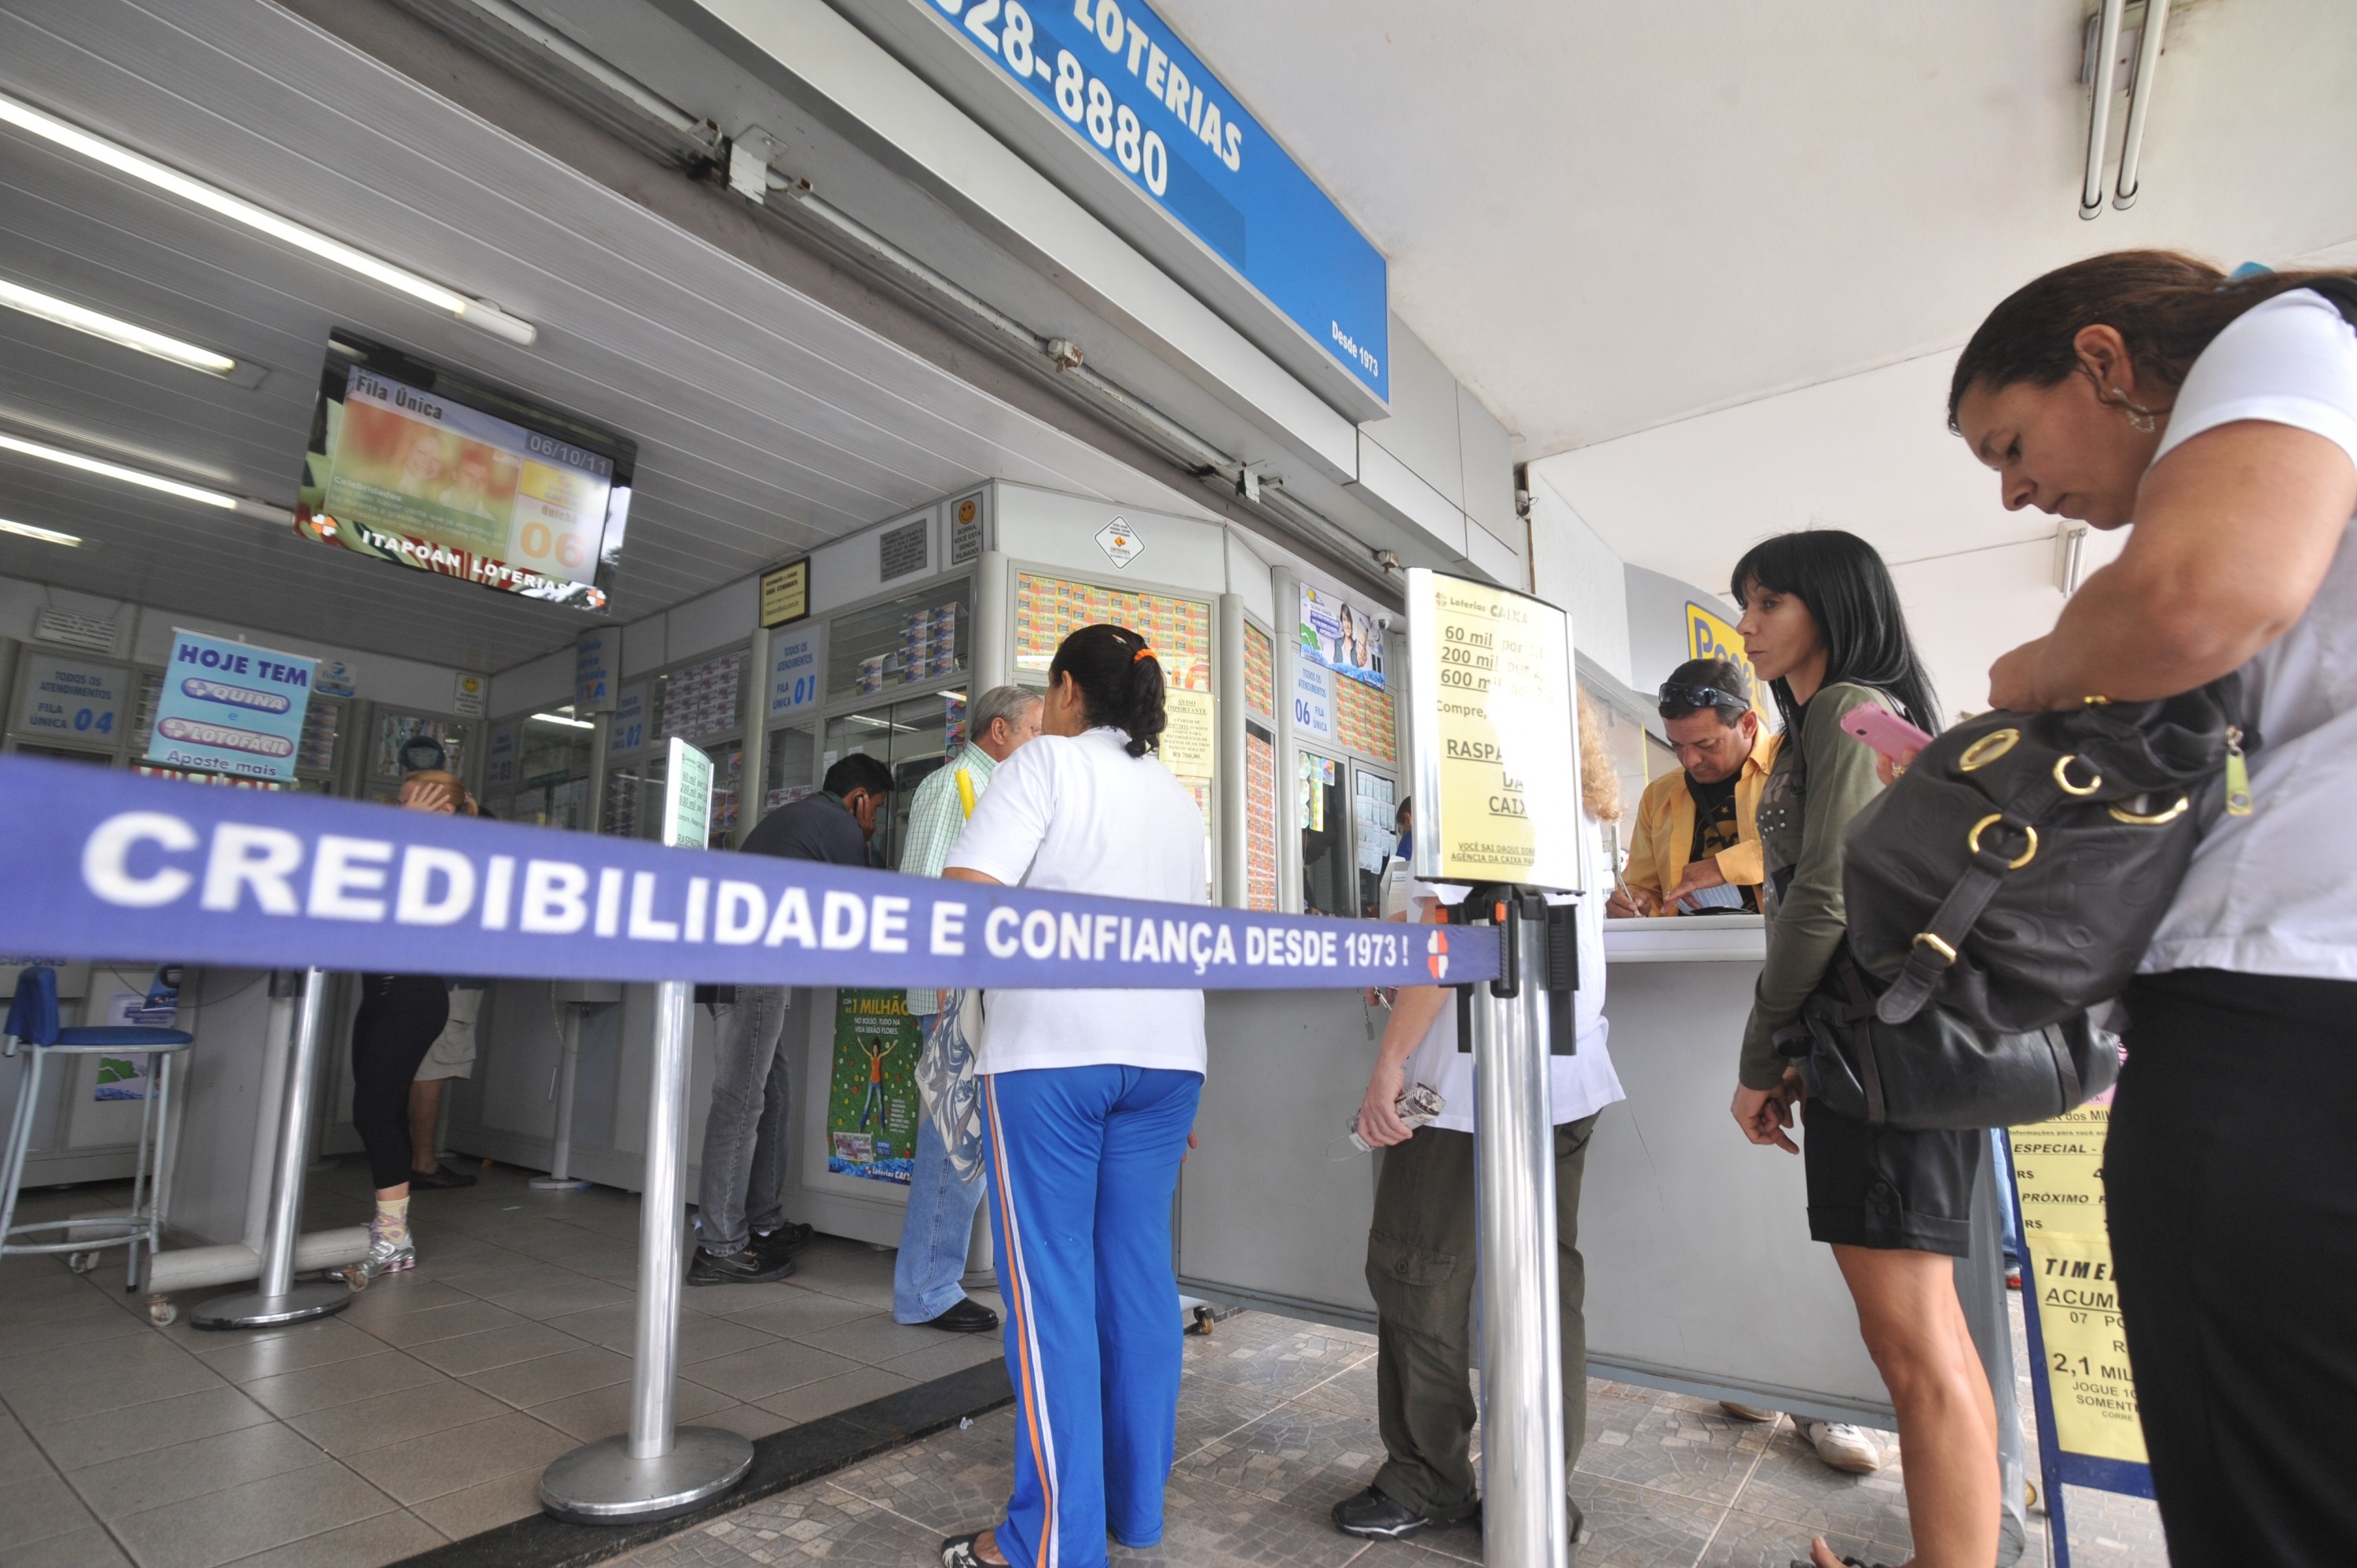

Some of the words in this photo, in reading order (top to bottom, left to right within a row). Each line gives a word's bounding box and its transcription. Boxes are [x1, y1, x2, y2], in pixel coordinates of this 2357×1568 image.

[1073, 0, 1241, 172] LOTERIAS
[936, 0, 1168, 196] 28-8880
[1332, 320, 1358, 358] Desde
[1359, 346, 1378, 377] 1973
[355, 374, 388, 401] Fila
[395, 387, 442, 420] Única
[530, 435, 607, 474] 06/10/11
[520, 521, 585, 569] 06
[362, 530, 461, 568] ITAPOAN
[473, 560, 568, 593] LOTERIAS
[1450, 597, 1486, 612] Loterias
[1445, 626, 1464, 641] 60
[1470, 632, 1493, 647] mil
[784, 644, 799, 657] TODOS
[801, 642, 808, 652] OS
[1441, 647, 1471, 664] 200
[1476, 654, 1499, 669] mil
[178, 643, 250, 675] HOJE
[258, 660, 307, 687] TEM
[777, 654, 812, 672] ATENDIMENTOS
[55, 671, 86, 684] TODOS
[89, 676, 101, 686] OS
[1303, 668, 1316, 681] TODOS
[1316, 674, 1321, 684] OS
[1441, 669, 1472, 687] 600
[40, 682, 112, 700] ATENDIMENTOS
[777, 682, 789, 694] FILA
[794, 675, 815, 704] 01
[1298, 679, 1326, 698] ATENDIMENTOS
[211, 686, 284, 710] QUINA
[773, 697, 791, 710] ÚNICA
[38, 702, 63, 714] FILA
[228, 712, 238, 720] e
[1168, 705, 1206, 714] IMPORTANTE
[1296, 698, 1310, 725] 06
[1315, 705, 1325, 716] FILA
[1437, 701, 1487, 720] Compre,
[30, 713, 68, 729] ÚNICA
[74, 708, 115, 735] 04
[1313, 716, 1328, 732] ÚNICA
[190, 726, 288, 755] LOTOFÁCIL
[627, 723, 642, 747] 02
[166, 750, 230, 771] Aposte
[236, 763, 277, 776] mais
[680, 783, 690, 793] 200
[680, 795, 689, 806] 600
[1458, 841, 1479, 851] VOCÊ
[1497, 844, 1519, 855] DAQUI
[1451, 851, 1486, 862] AGÊNCIA
[1501, 855, 1522, 864] CAIXA
[80, 811, 908, 953] CREDIBILIDADE
[930, 902, 967, 956] E
[984, 905, 1237, 976] CONFIANÇA
[1246, 926, 1337, 967] DESDE
[1344, 932, 1397, 968] 1973
[852, 998, 857, 1013] 1
[860, 995, 910, 1016] MILHÃO
[866, 1025, 880, 1034] SERÃO
[2066, 1112, 2087, 1121] dos
[2014, 1144, 2087, 1153] ESPECIAL
[872, 1167, 894, 1177] Loterias
[2017, 1170, 2034, 1179] R$
[2022, 1192, 2089, 1203] PRÓXIMO
[2025, 1219, 2043, 1229] R$
[2046, 1288, 2114, 1308] ACUM
[2069, 1311, 2088, 1324] 07
[2113, 1340, 2125, 1353] R
[2053, 1353, 2090, 1376] 2,1
[2101, 1365, 2134, 1381] MIL
[2073, 1381, 2118, 1396] JOGUE
